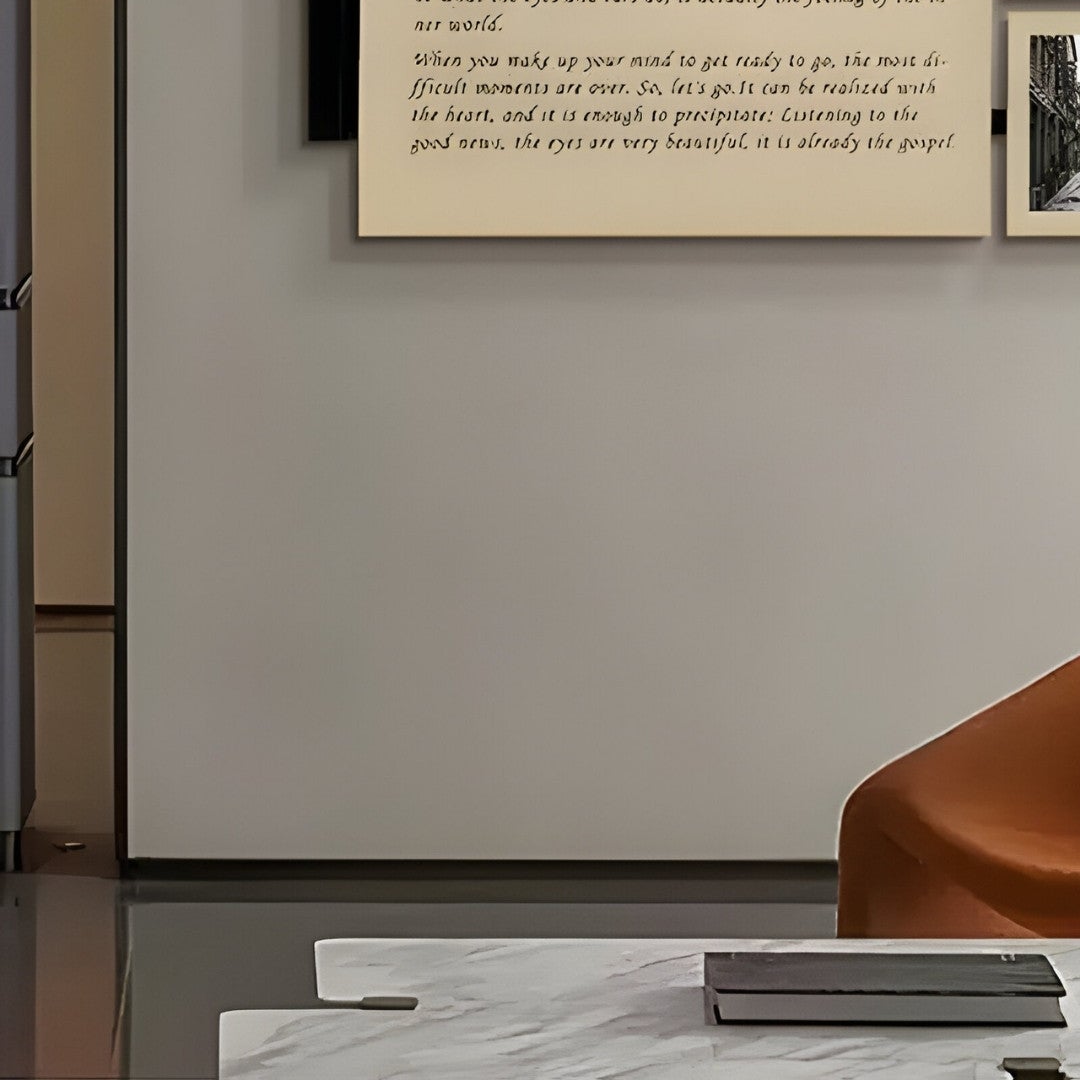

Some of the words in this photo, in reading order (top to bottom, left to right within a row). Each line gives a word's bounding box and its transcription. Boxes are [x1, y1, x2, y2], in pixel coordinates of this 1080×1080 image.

[414, 20, 442, 32] ner
[448, 13, 504, 33] world.
[413, 49, 462, 68] When
[466, 55, 500, 73] you
[507, 50, 551, 72] make
[557, 56, 579, 73] up
[582, 55, 626, 73] your
[629, 49, 676, 68] mind
[679, 55, 697, 68] to
[700, 54, 729, 73] get
[735, 50, 783, 73] ready
[788, 54, 805, 68] to
[844, 50, 872, 68] the
[876, 55, 917, 68] most
[475, 83, 549, 95] moments
[555, 83, 583, 95] are
[761, 82, 790, 96] can
[798, 77, 816, 96] be
[822, 76, 895, 95] realized
[896, 77, 936, 95] with
[411, 105, 439, 122] the
[502, 104, 539, 123] and
[541, 109, 556, 122] it
[562, 109, 577, 122] is
[583, 104, 644, 127] enough
[651, 109, 668, 123] to
[780, 106, 862, 127] Listening
[869, 109, 886, 122] to
[893, 104, 919, 122] the
[409, 131, 455, 156] good
[514, 132, 541, 150] the
[547, 137, 583, 156] eyes
[589, 138, 616, 150] are
[622, 136, 659, 155] very
[756, 133, 770, 149] it
[777, 134, 792, 149] is
[797, 131, 861, 154] already
[867, 132, 894, 150] the
